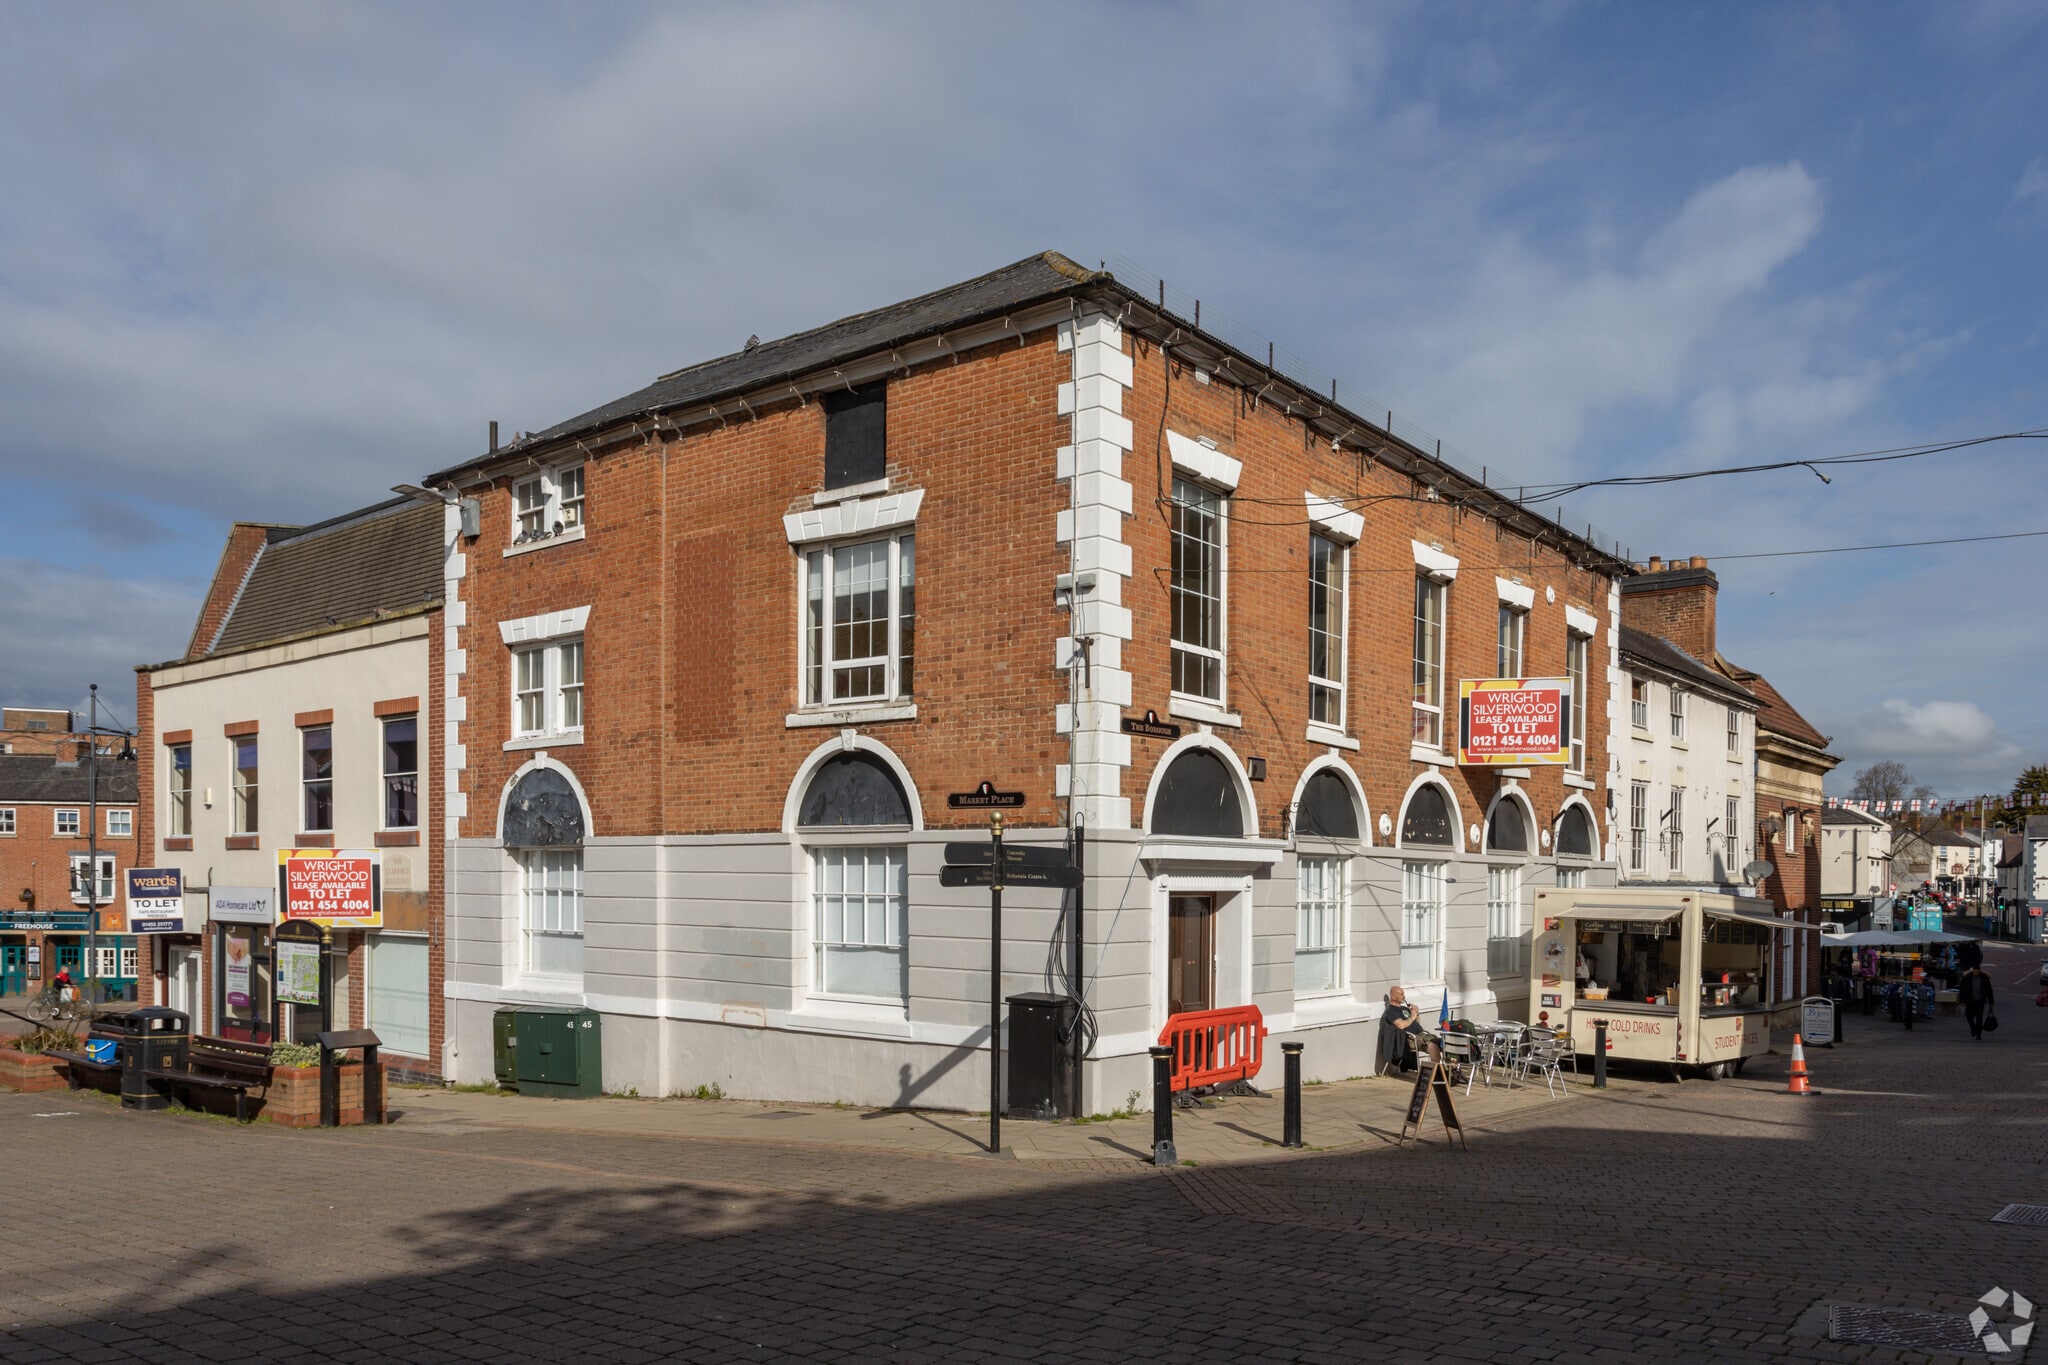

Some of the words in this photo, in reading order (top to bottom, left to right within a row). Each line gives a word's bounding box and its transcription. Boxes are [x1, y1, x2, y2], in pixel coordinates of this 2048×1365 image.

[1488, 692, 1543, 704] WRIGHT
[1473, 703, 1557, 715] SILVERWOOD
[1505, 715, 1554, 723] AVAILABLE
[1131, 722, 1144, 732] THE
[1145, 724, 1172, 735] BOROUGH
[1492, 723, 1510, 734] TO
[1514, 722, 1538, 734] LET
[1472, 736, 1497, 746] 0121
[1500, 735, 1522, 746] 454
[1527, 734, 1557, 745] 4004
[959, 796, 989, 804] MARKET
[991, 796, 1014, 804] PLACE
[304, 861, 355, 871] WRIGHT
[133, 875, 177, 887] wards
[290, 871, 368, 881] SILVERWOOD
[308, 889, 325, 899] TO
[330, 889, 352, 898] LET
[155, 899, 178, 907] LET
[291, 901, 314, 910] 0121
[318, 900, 338, 910] 454
[342, 900, 369, 910] 4004
[1611, 1019, 1631, 1032] COLD
[1633, 1020, 1661, 1034] DRINKS
[1715, 1034, 1740, 1049] STUDENT
